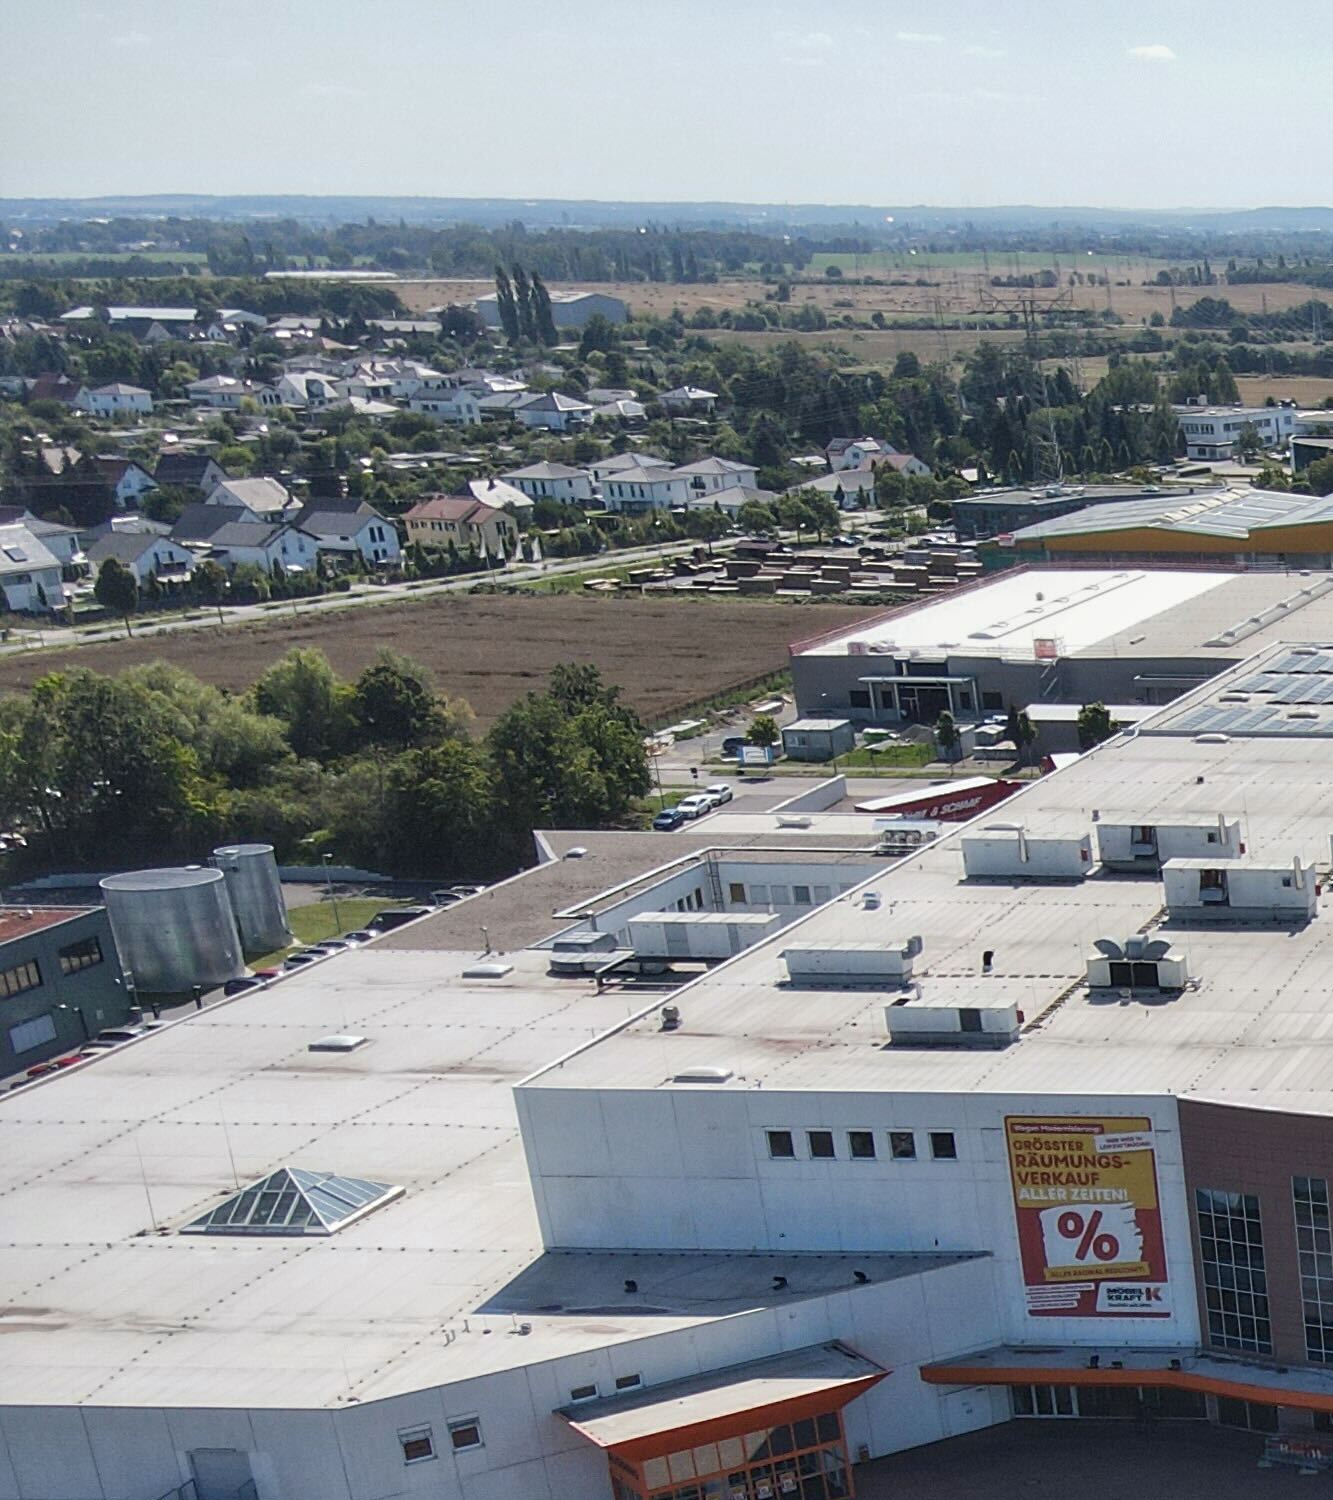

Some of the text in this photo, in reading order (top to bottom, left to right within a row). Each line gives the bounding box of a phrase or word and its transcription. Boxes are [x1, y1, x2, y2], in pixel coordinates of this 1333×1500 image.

[1013, 1137, 1084, 1152] GRÖSSTER
[1015, 1152, 1132, 1169] RÄUMUNGS-
[1017, 1171, 1100, 1186] VERKAUF
[1019, 1187, 1128, 1201] ALLER ZEITEN!
[1106, 1286, 1144, 1295] MÖBEL
